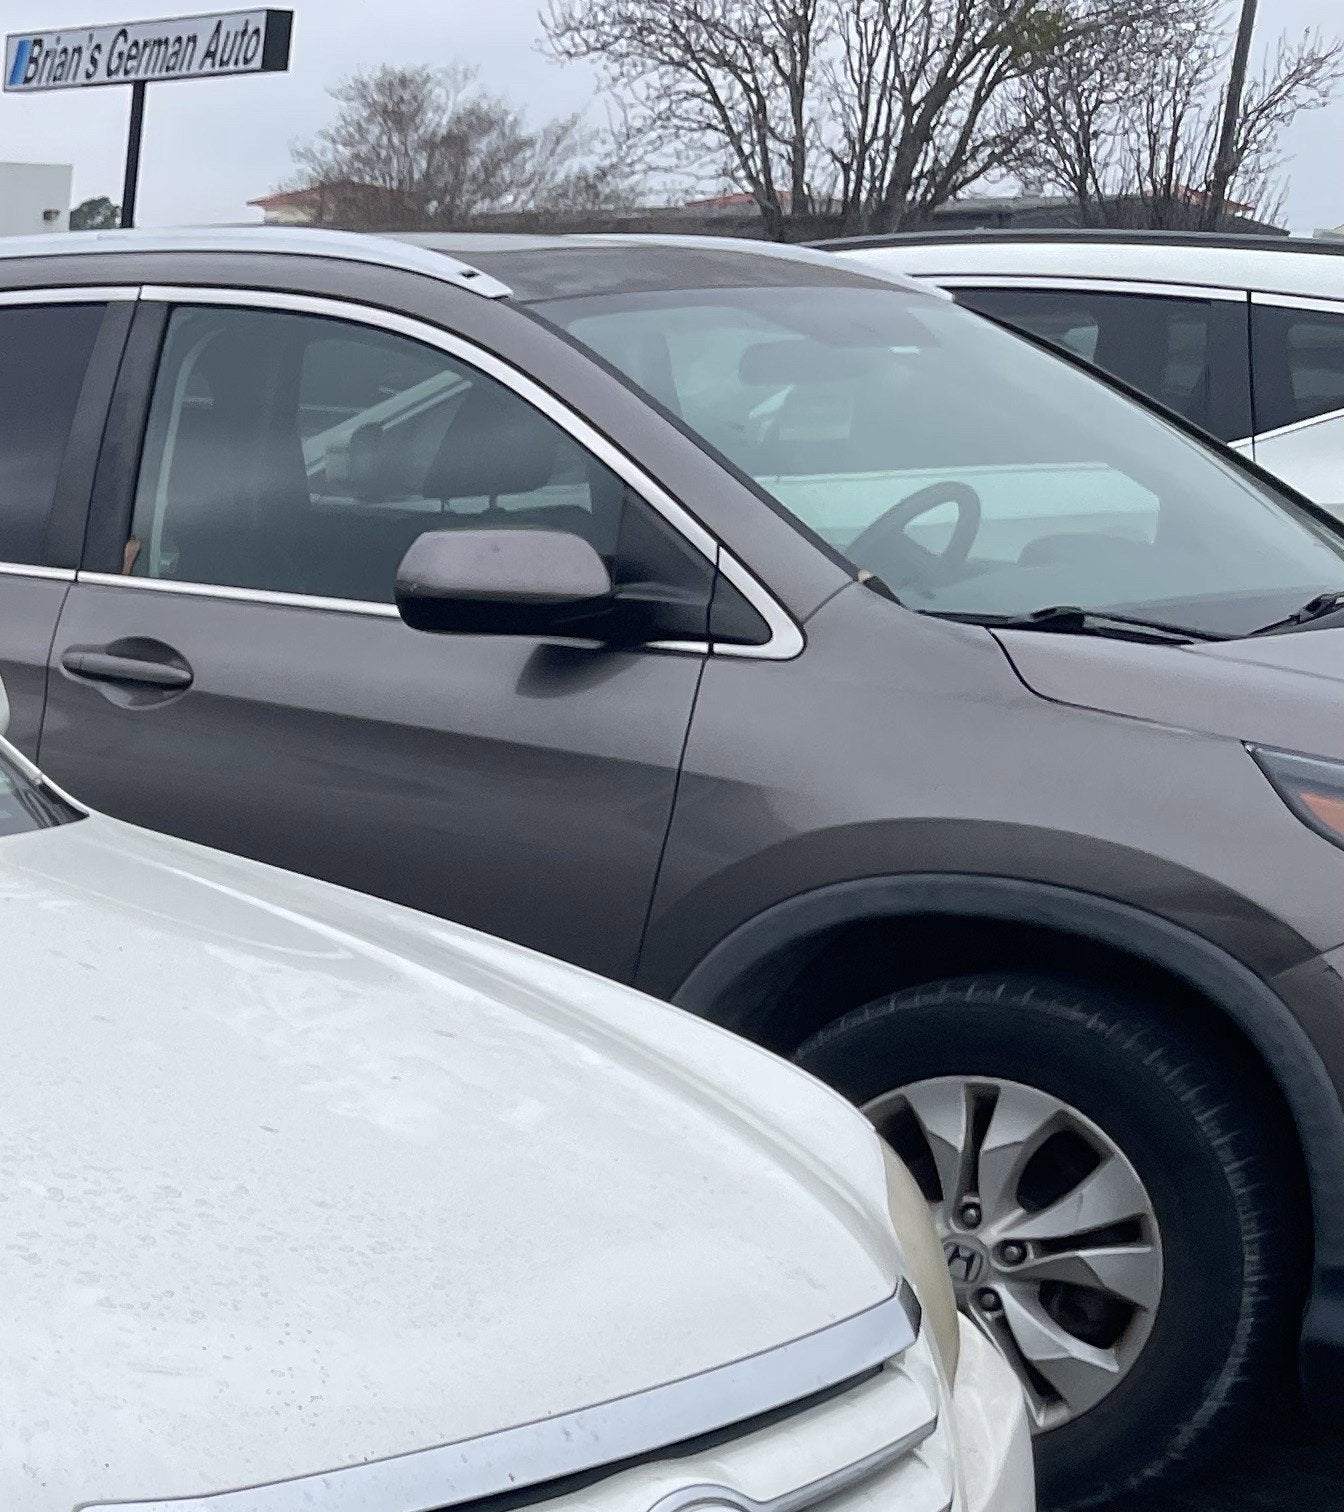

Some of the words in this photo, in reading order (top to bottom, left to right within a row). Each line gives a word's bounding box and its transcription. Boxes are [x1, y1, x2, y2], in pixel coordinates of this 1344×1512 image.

[23, 33, 102, 84] Brian's
[106, 28, 197, 78] German
[199, 19, 261, 70] Auto
